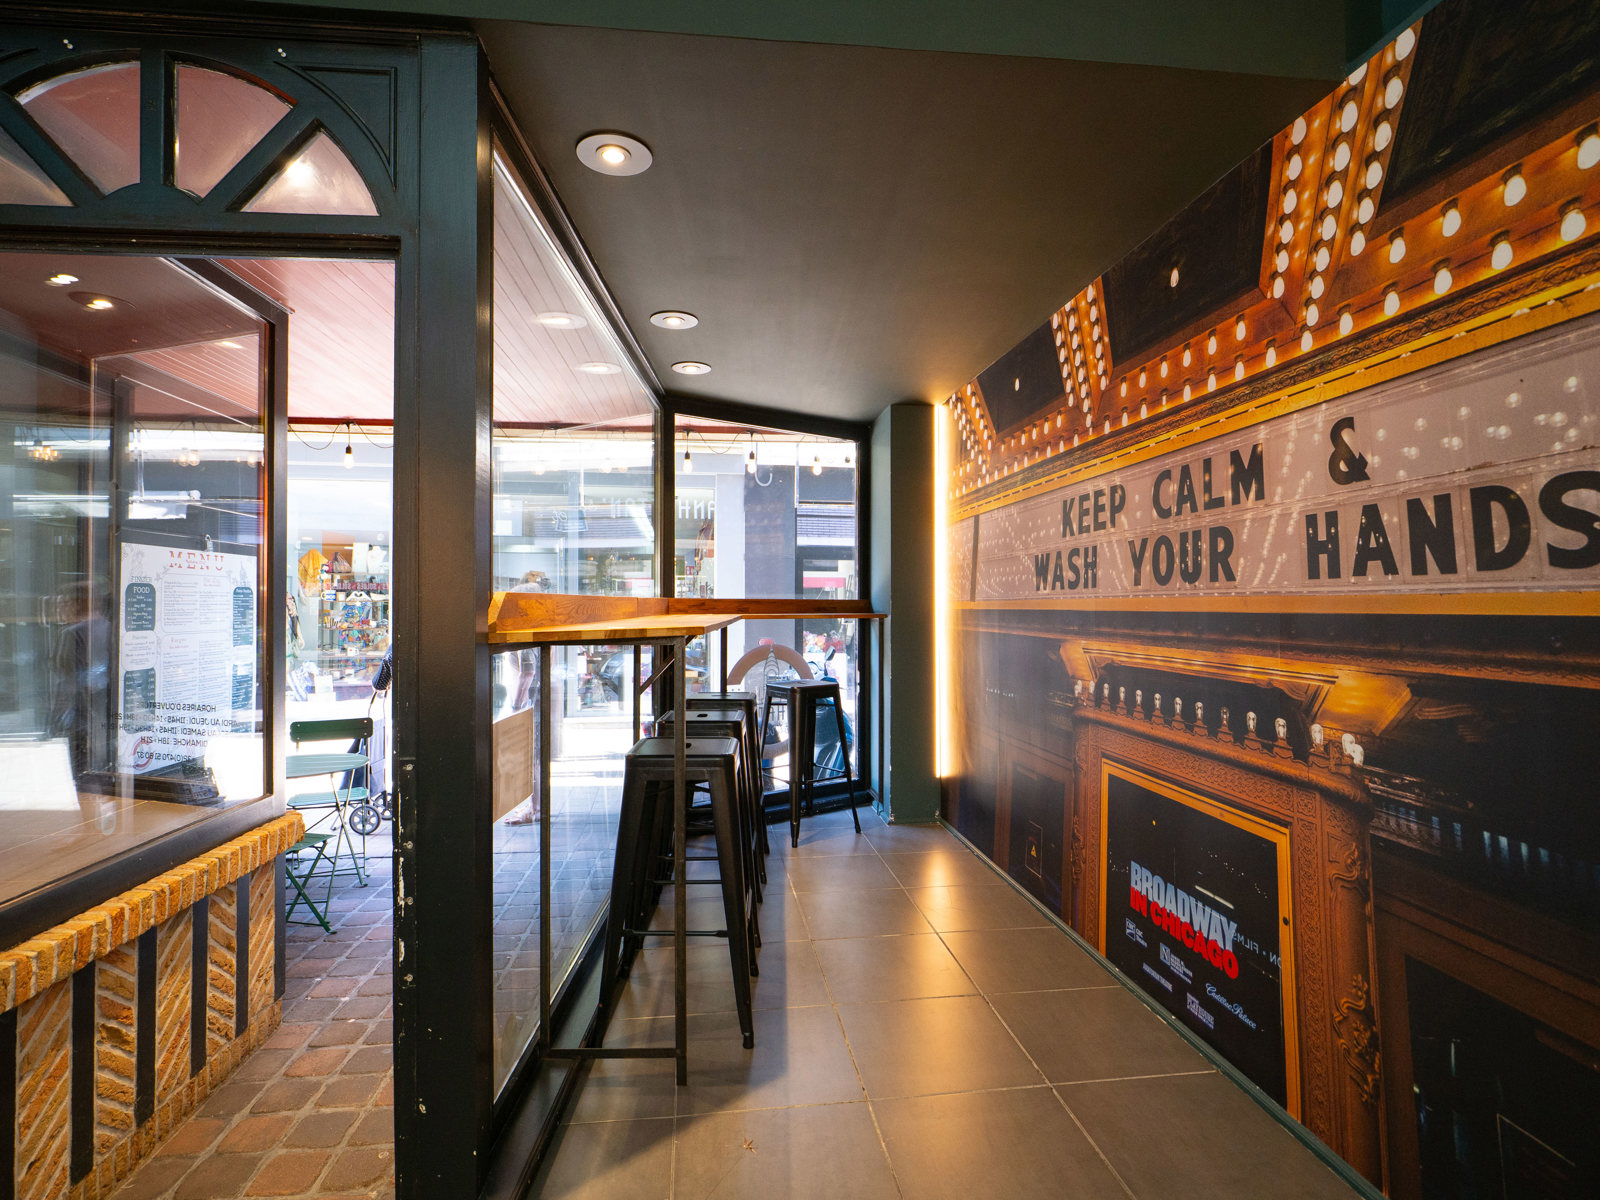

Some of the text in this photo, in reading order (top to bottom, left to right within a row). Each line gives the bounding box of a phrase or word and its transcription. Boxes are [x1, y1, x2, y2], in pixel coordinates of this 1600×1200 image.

[1062, 416, 1371, 538] KEEP CALM &
[169, 550, 225, 571] MENU
[1034, 470, 1600, 592] WASH YOUR HANDS
[133, 586, 151, 594] FOOD
[1130, 860, 1238, 951] BROADWAY
[1130, 886, 1148, 917] IN
[1150, 901, 1239, 979] CHICAGO
[1205, 982, 1234, 1012] Cadillac
[1231, 1003, 1257, 1031] Palace
